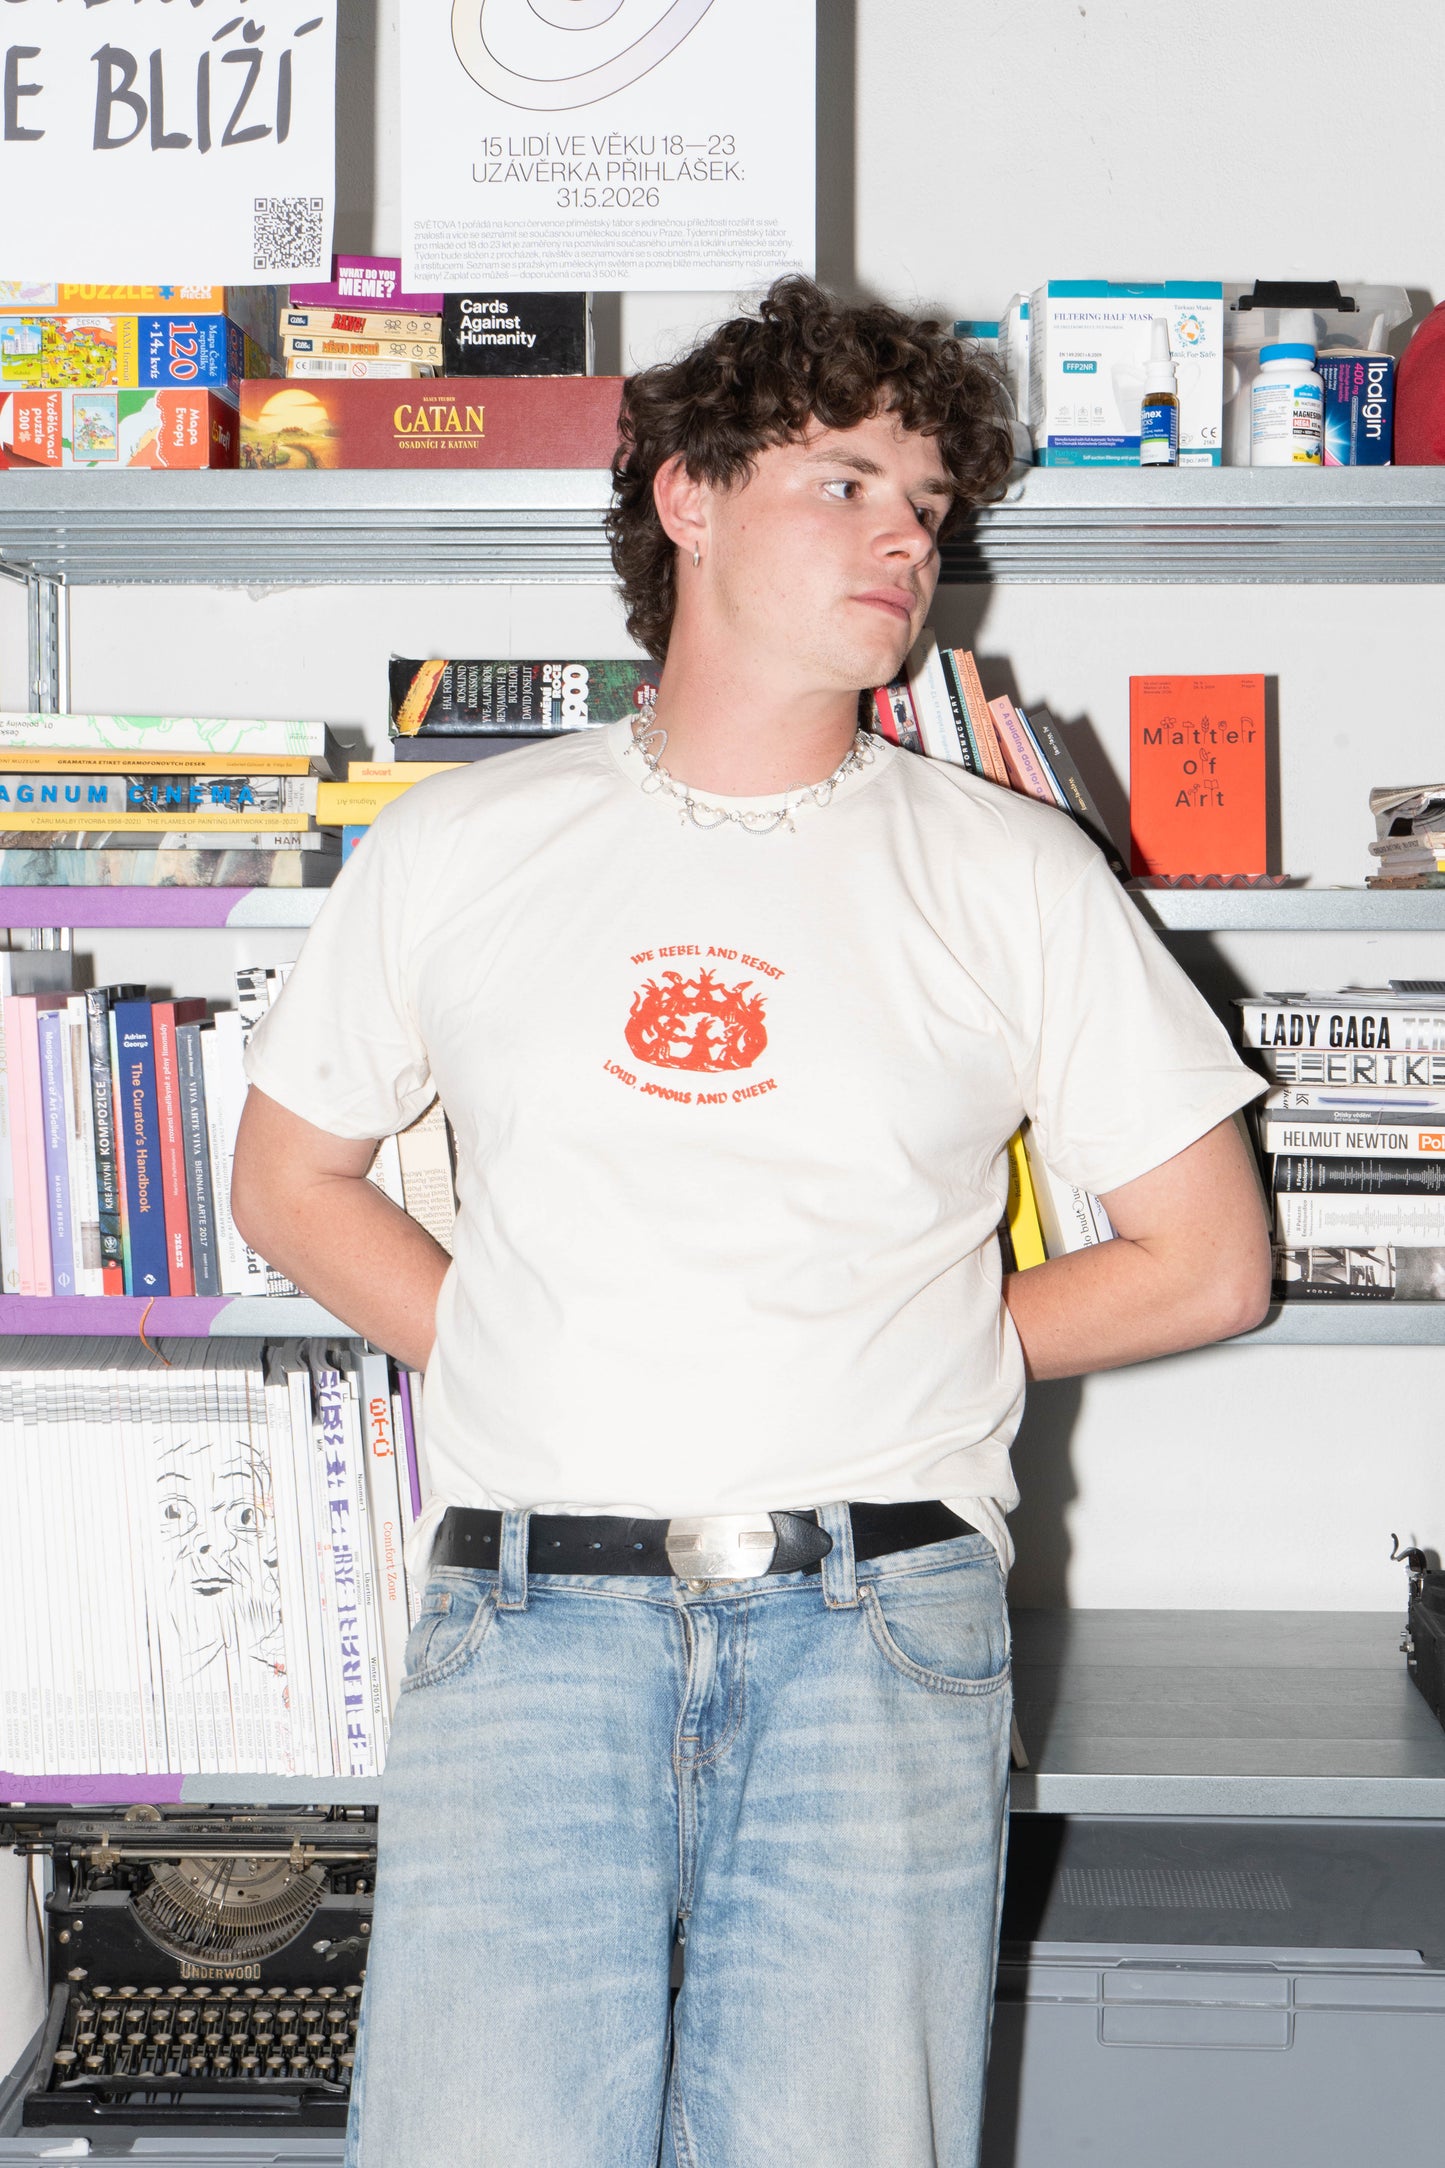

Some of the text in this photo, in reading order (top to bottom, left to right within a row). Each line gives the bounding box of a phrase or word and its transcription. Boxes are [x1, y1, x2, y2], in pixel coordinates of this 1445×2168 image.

[90, 16, 323, 155] BLÍŽÍ
[481, 137, 502, 157] 15
[508, 133, 550, 157] LIDÍ
[555, 136, 586, 157] VE
[591, 133, 656, 157] VĚKU
[472, 158, 745, 183] UZÁVĚRKA PŘIHLÁŠEK:
[556, 187, 660, 208] 31.5.2026
[63, 284, 155, 300] PUZZLE
[338, 278, 396, 298] MEME?
[339, 268, 396, 280] WHAT DO YOU
[460, 299, 508, 314] Cards
[460, 315, 521, 332] Against
[1054, 312, 1153, 321] FILTERING HALF MASK
[169, 321, 199, 381] 120
[199, 331, 208, 371] republiky
[207, 324, 218, 377] Mapa České
[460, 330, 537, 348] Humanity
[150, 357, 161, 379] kvíz
[1066, 362, 1094, 371] FFP2NR
[1352, 362, 1364, 395] 400 mg
[1362, 362, 1388, 437] Ibalgin
[19, 409, 30, 430] 200
[31, 408, 45, 445] puzzle
[47, 393, 58, 459] Vzdělávací
[173, 407, 187, 447] Evropy
[189, 408, 199, 445] Mapa
[393, 404, 486, 433] CATAN
[399, 438, 480, 449] OSADNÍCI Z KATANU
[442, 665, 452, 710] HAL FOSTER
[457, 665, 467, 703] ROSALIND
[467, 665, 478, 708] KRAUSSOVÁ
[482, 665, 492, 723] YVE-ALAIN BOIS
[508, 665, 518, 703] BUCHLOH
[522, 665, 534, 720] DAVID JOSELIT
[540, 664, 552, 729] UMĚNÍ PO
[552, 664, 562, 698] ROCE
[562, 664, 589, 729] 1900
[496, 684, 508, 722] BENJAMIN
[1005, 719, 1027, 754] guiding
[1020, 754, 1035, 772] dog
[1029, 772, 1040, 785] for
[1143, 727, 1256, 745] Matter
[361, 767, 392, 777] slovart
[128, 784, 255, 804] CINEMA
[349, 798, 377, 806] Magnus
[1175, 789, 1224, 807] Art
[630, 944, 785, 980] WE REBEL AND RESIST
[123, 1040, 148, 1049] George
[124, 1033, 147, 1041] Adrian
[1260, 1012, 1391, 1049] LADY GAGA
[44, 1031, 60, 1148] Management of Art Galleries
[159, 1023, 175, 1143] zrození umělkyně pěny limonády
[603, 1059, 637, 1089] LOUD,
[696, 1092, 728, 1105] AND
[732, 1078, 778, 1103] QUEER
[95, 1081, 113, 1209] KREATIVNÍ KOMPOZICE
[131, 1062, 152, 1213] The Curator's Handbook
[211, 1123, 219, 1160] MODERNISM
[1283, 1130, 1445, 1150] HELMUT NEWTON Pol
[189, 1082, 208, 1246] VIVA ARTE VIVA BIENNALE ARTE 2017
[214, 1161, 222, 1189] OPENING
[55, 1175, 64, 1238] MAGNUS RESCH
[219, 1217, 227, 1238] OSKAR
[356, 1473, 365, 1505] Nummer
[383, 1521, 397, 1600] Comfort Zone
[364, 1571, 373, 1606] Libertine
[371, 1656, 381, 1713] Winter 2015/16
[180, 1963, 261, 1980] UNDERWOOD
